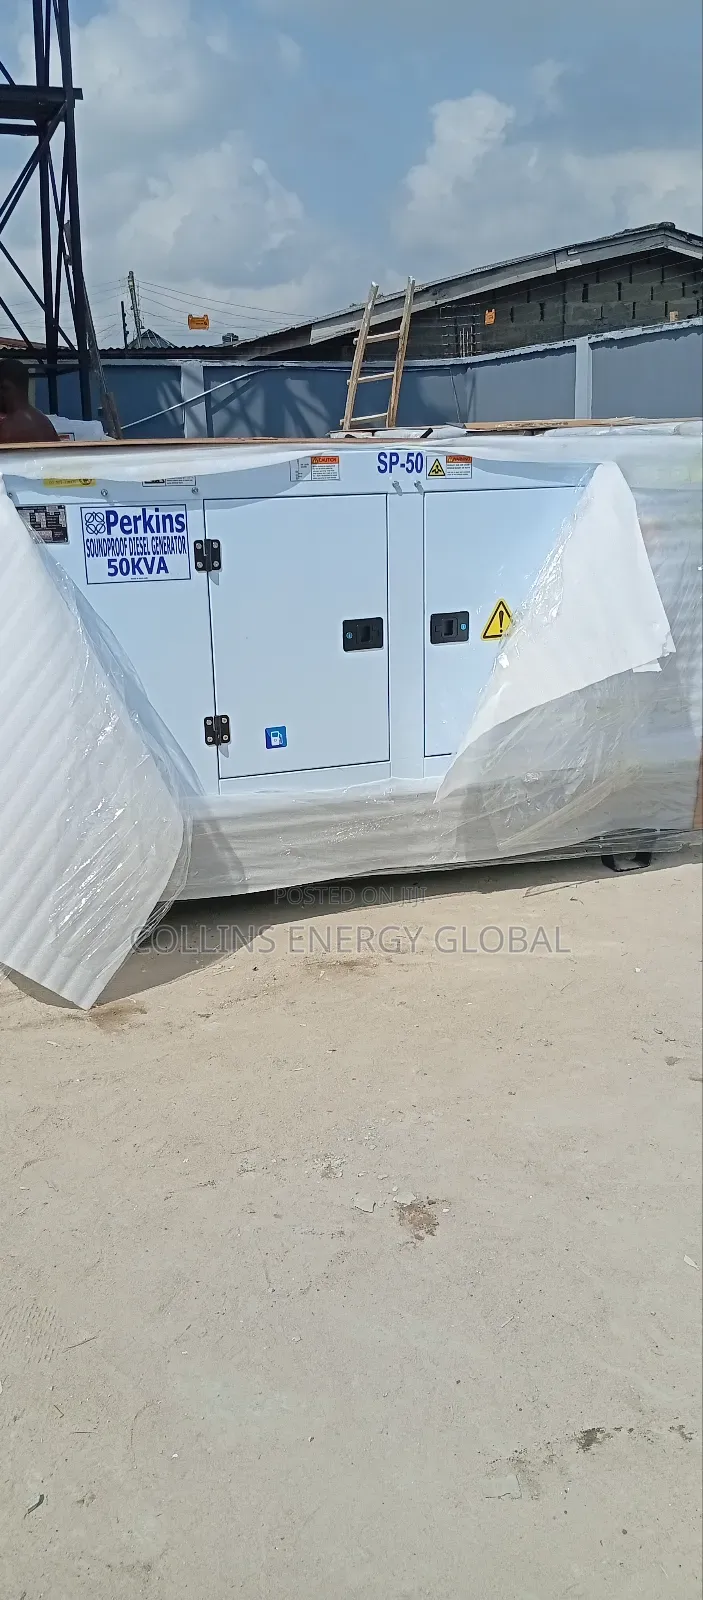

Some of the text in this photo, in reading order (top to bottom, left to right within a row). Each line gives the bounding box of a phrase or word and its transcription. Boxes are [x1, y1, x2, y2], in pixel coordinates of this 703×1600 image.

[377, 452, 424, 474] SP-50
[106, 508, 185, 535] Perkins
[86, 535, 187, 558] SOUNDPROOF DIESEL GENERATOR
[107, 557, 169, 576] 50KVA
